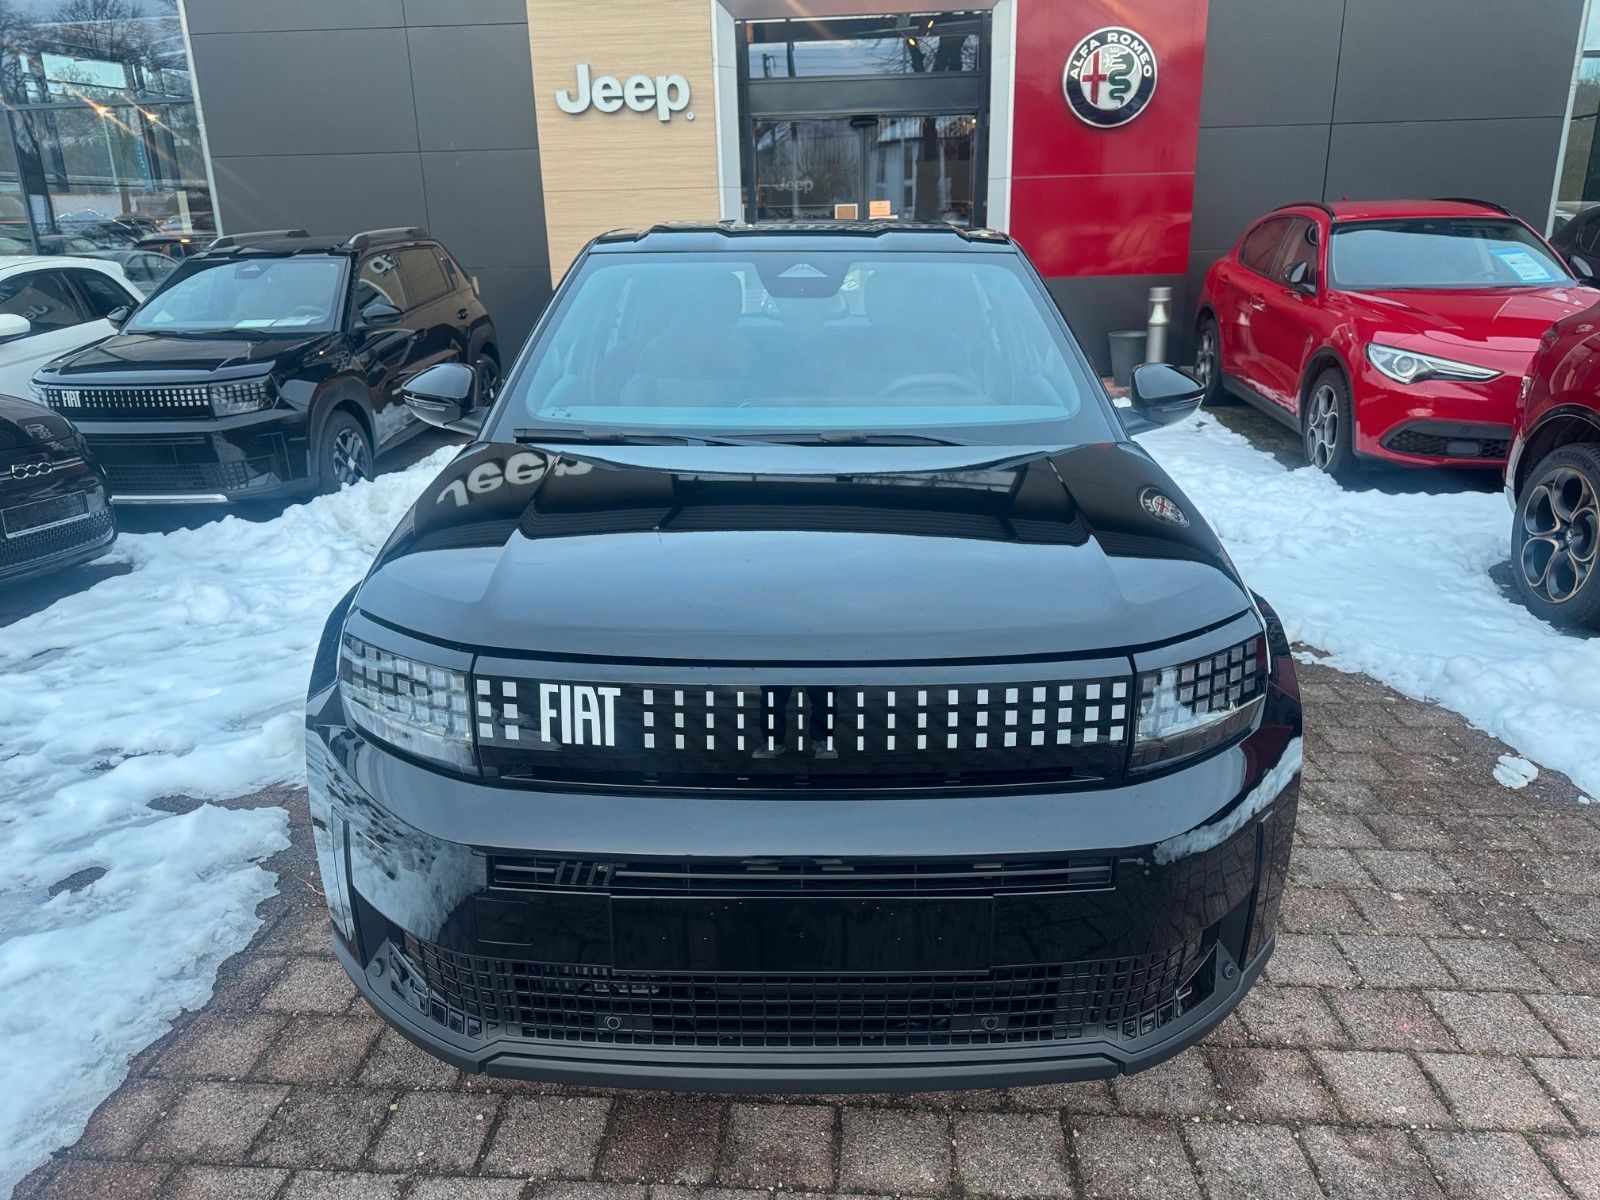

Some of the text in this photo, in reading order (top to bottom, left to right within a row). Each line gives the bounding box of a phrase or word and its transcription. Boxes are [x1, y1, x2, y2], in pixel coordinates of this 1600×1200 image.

[1070, 32, 1152, 79] ALFA ROMEO
[555, 63, 691, 121] Jeep
[775, 176, 814, 194] Jeep
[61, 390, 81, 408] FIAT
[11, 462, 52, 480] 500
[539, 683, 621, 747] FIAT
